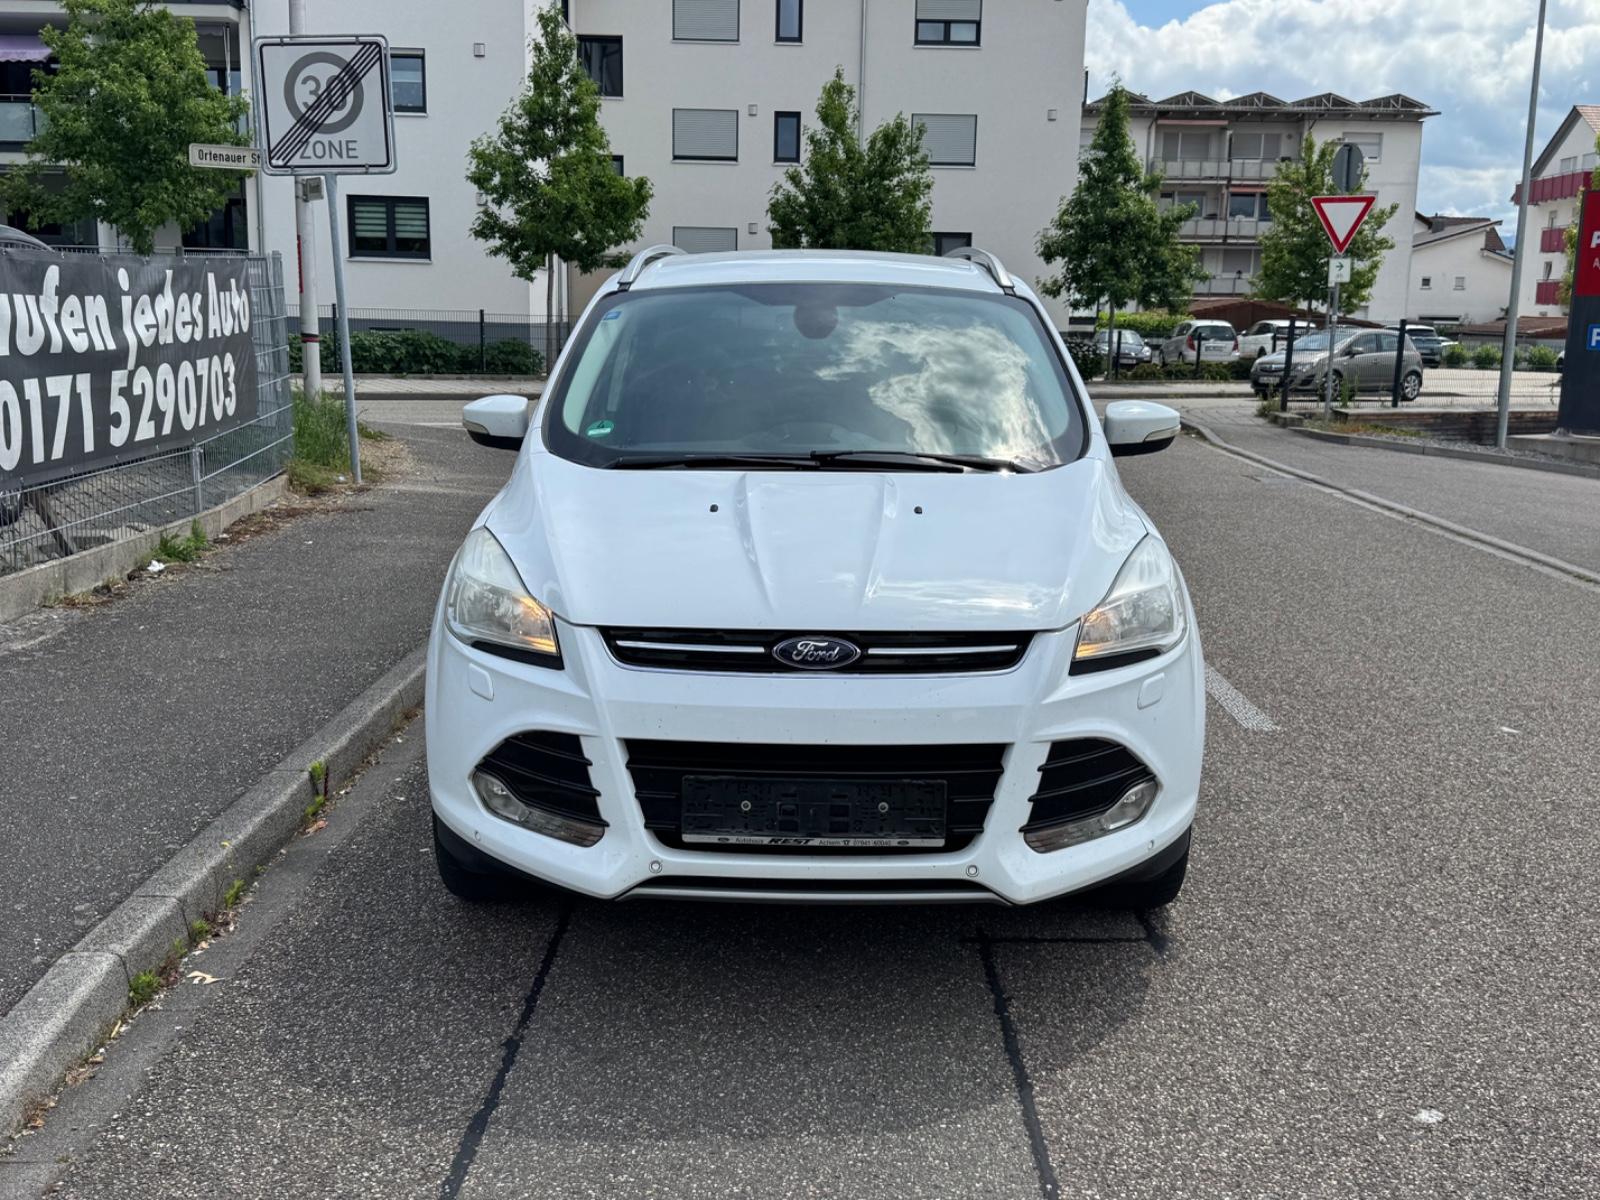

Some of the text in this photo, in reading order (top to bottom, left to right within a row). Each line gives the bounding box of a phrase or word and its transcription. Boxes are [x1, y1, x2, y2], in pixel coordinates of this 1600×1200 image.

[301, 75, 347, 113] 30
[198, 149, 246, 163] Ortenauer
[300, 140, 359, 159] ZONE
[118, 267, 203, 371] jedes
[207, 272, 250, 339] Auto
[0, 352, 236, 471] 0171 5290703
[792, 641, 839, 661] Ford
